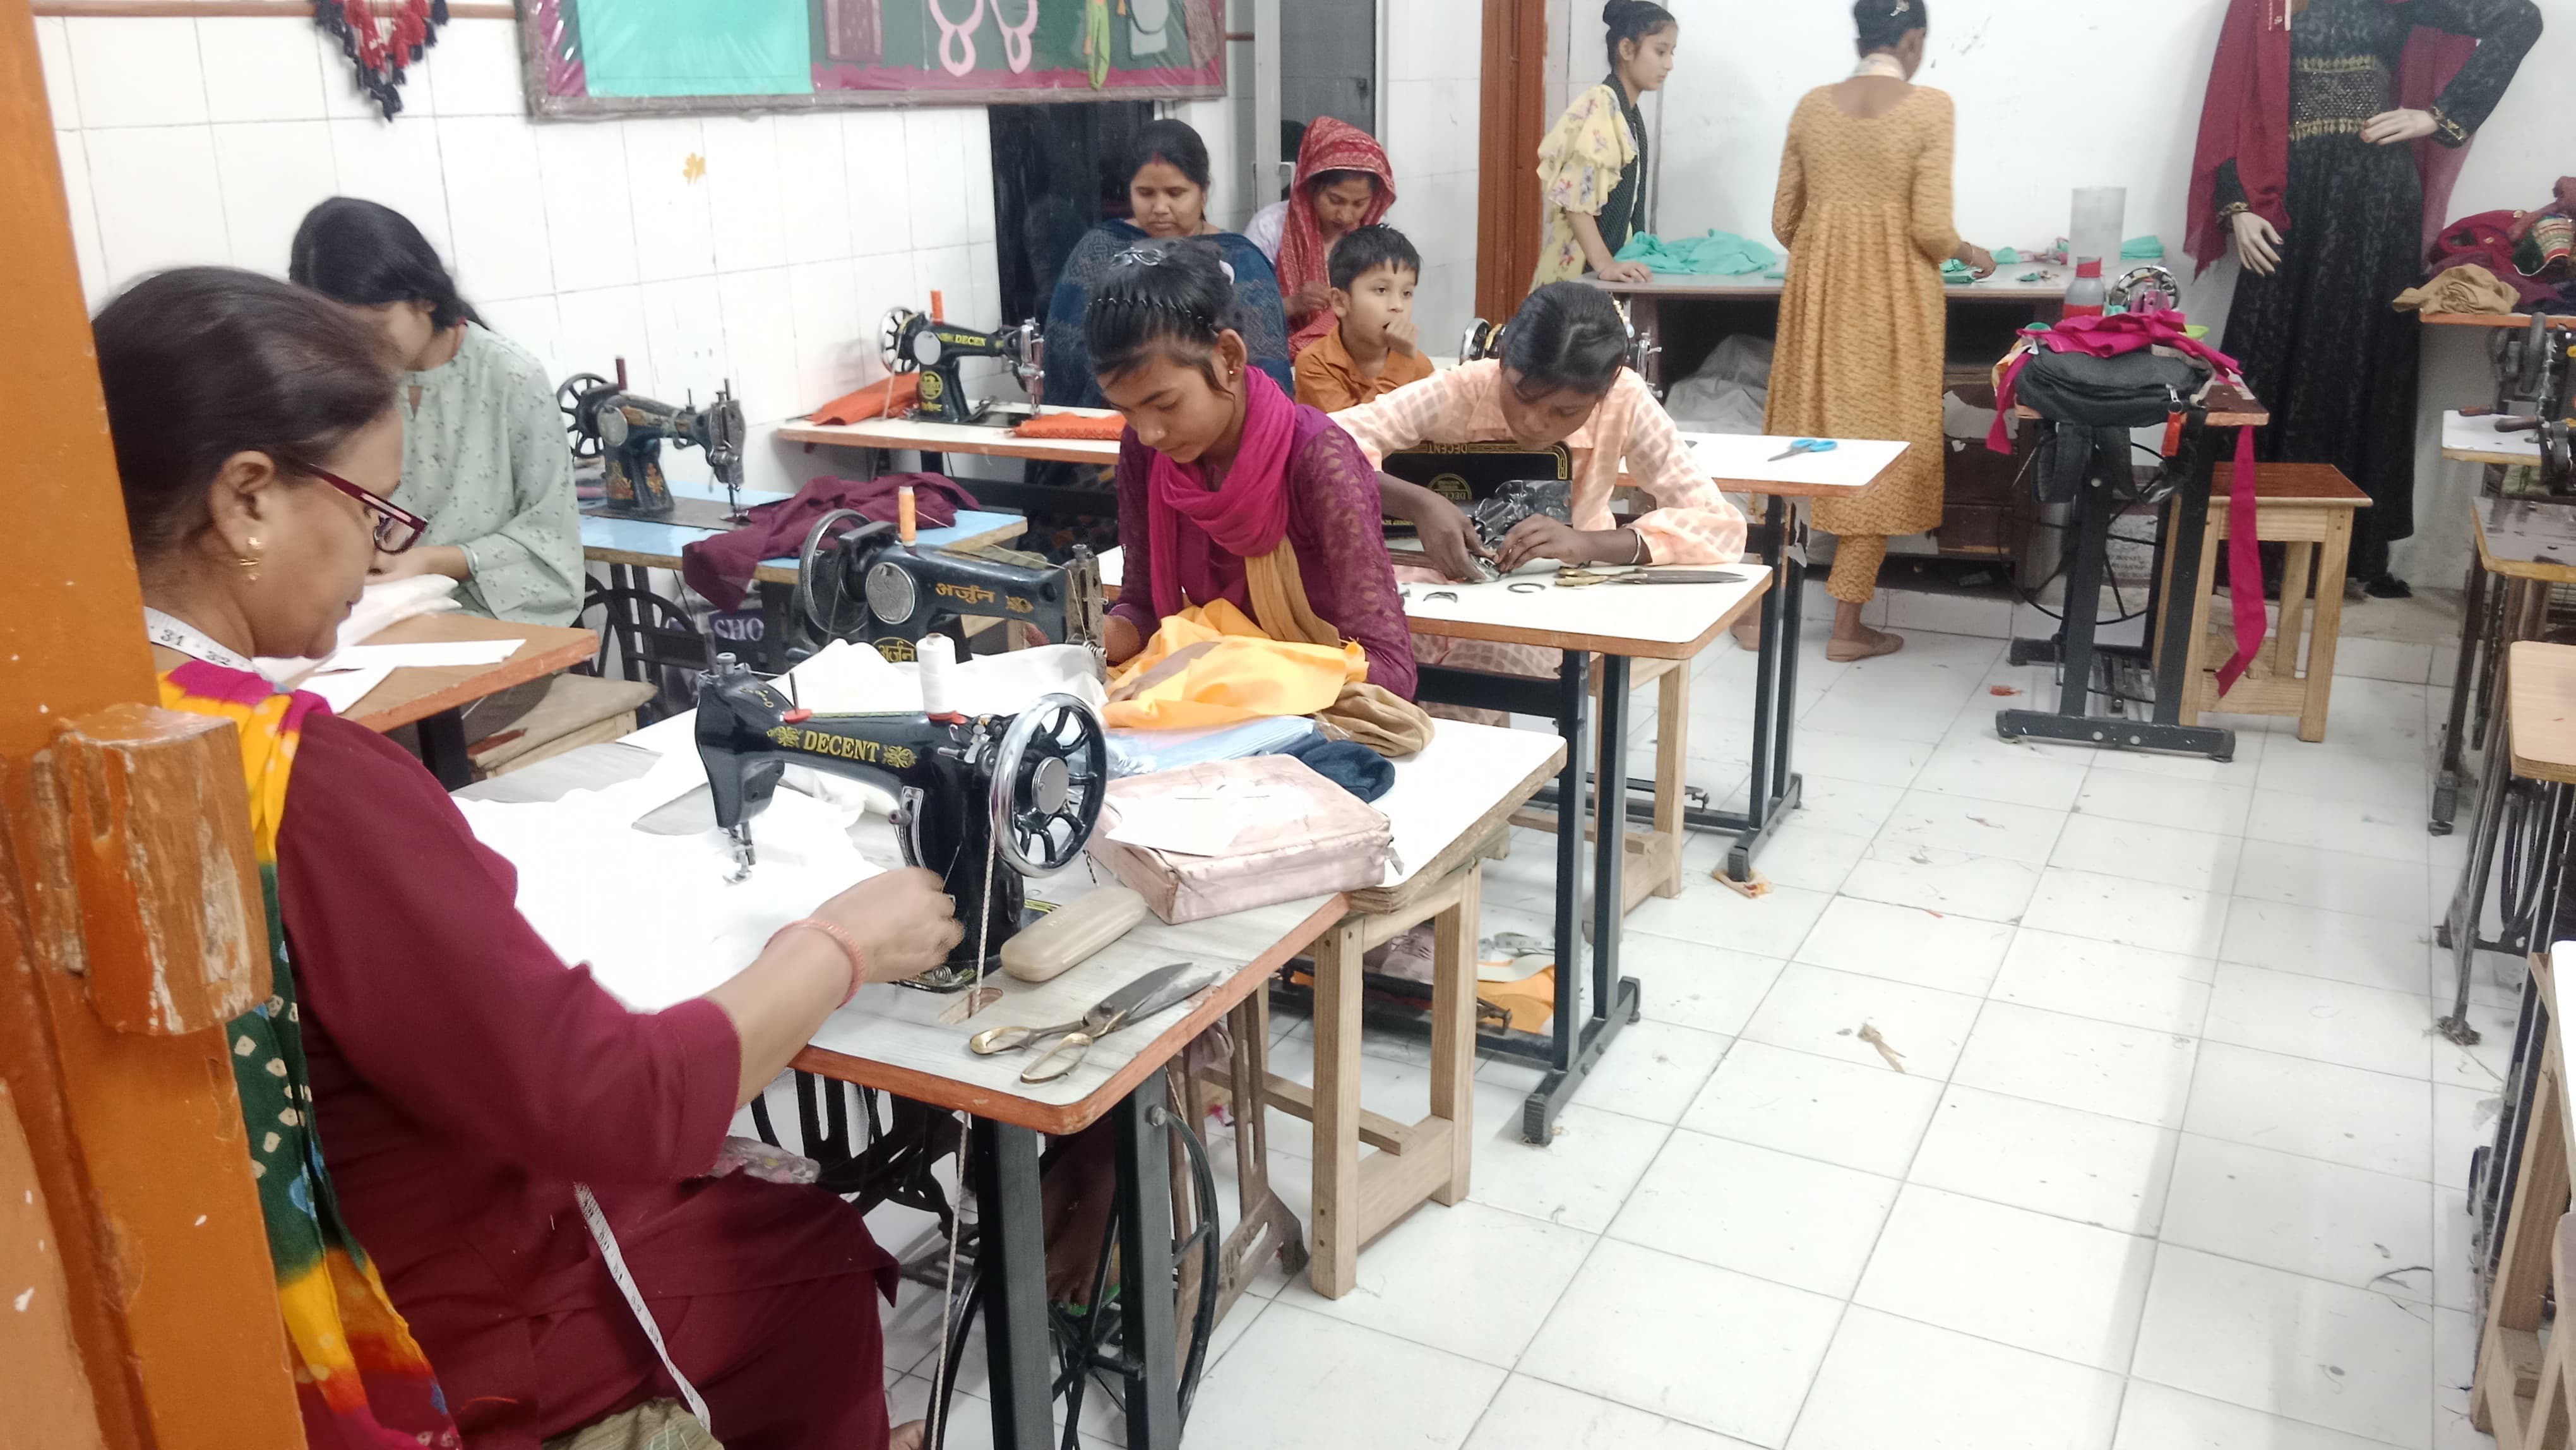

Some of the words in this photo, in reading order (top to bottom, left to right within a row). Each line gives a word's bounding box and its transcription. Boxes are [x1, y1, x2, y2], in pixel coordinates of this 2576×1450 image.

[955, 334, 987, 347] DECEN
[1428, 444, 1468, 453] DECENT
[936, 582, 995, 603] अर्जुन
[160, 629, 184, 646] 31
[205, 650, 230, 665] 32
[803, 730, 880, 762] DECENT
